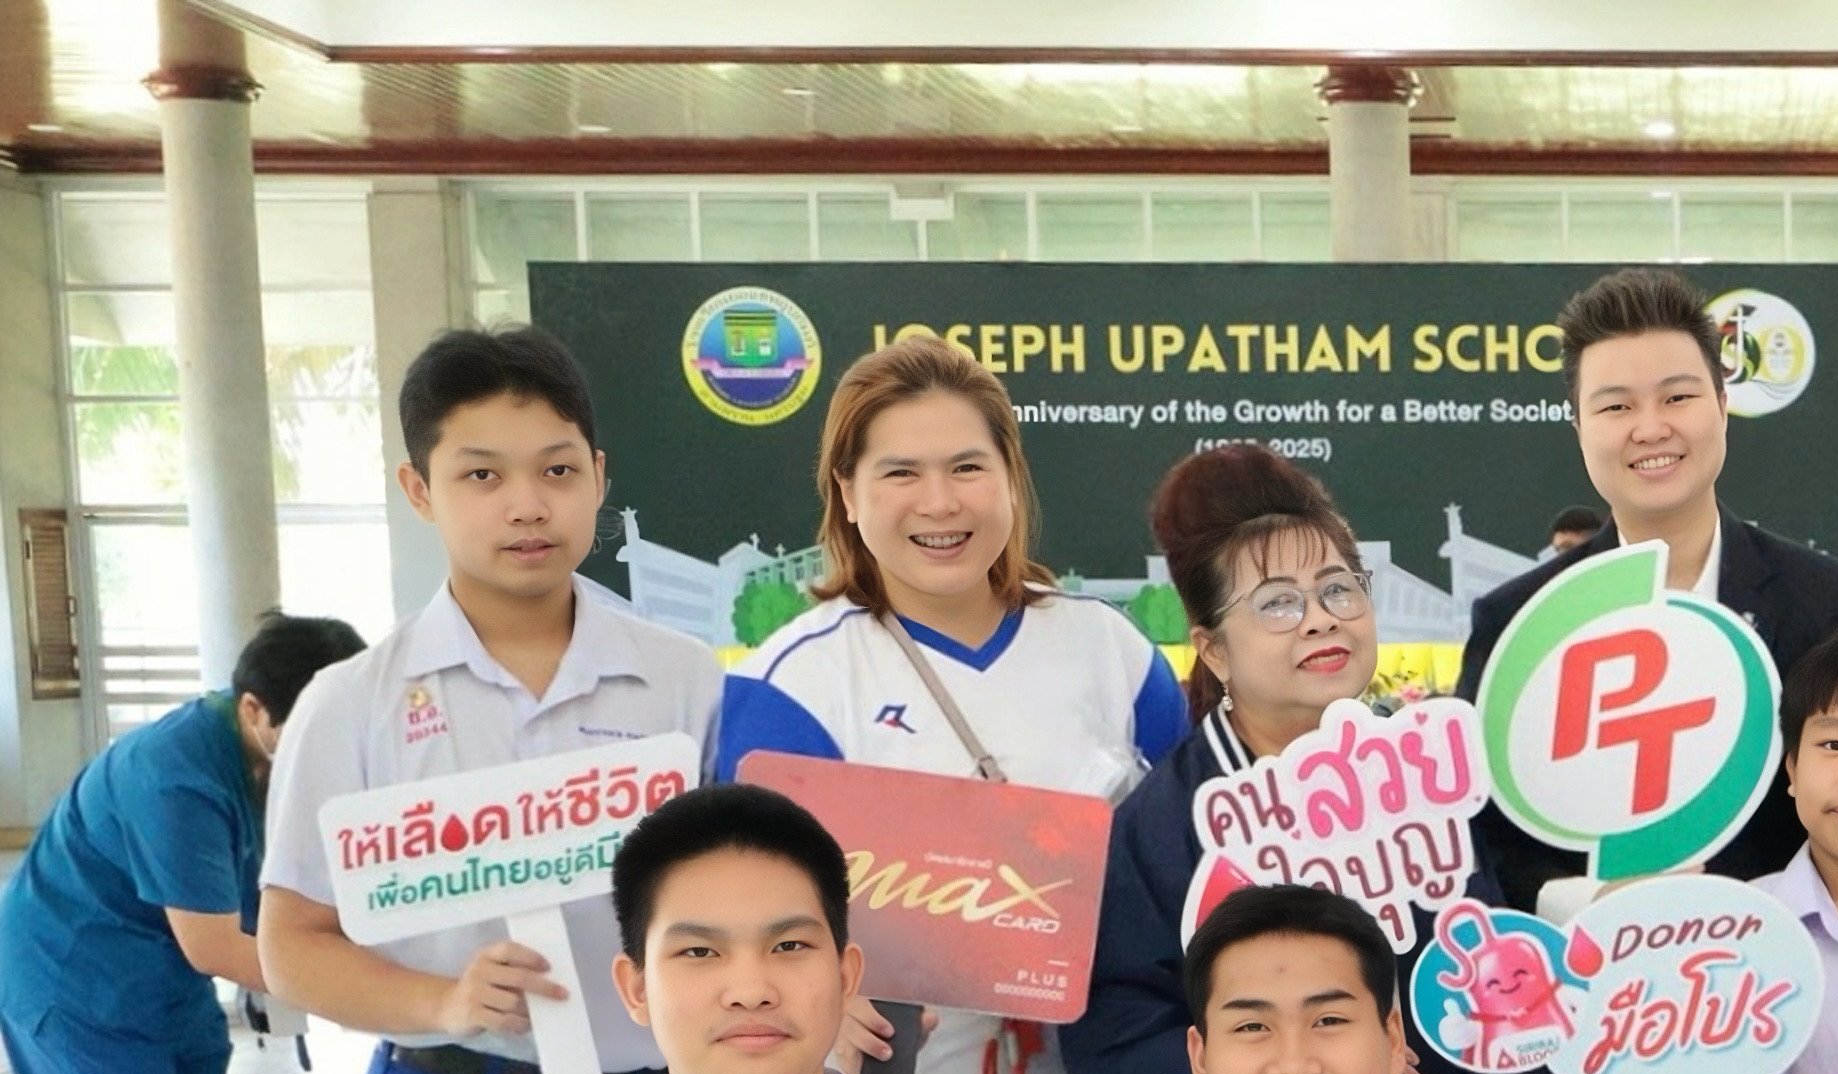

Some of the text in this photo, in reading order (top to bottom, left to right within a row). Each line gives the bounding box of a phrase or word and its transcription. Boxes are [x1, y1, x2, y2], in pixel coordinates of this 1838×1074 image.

[1109, 324, 1390, 372] UPATHAM
[1414, 324, 1566, 372] SCHO
[1012, 399, 1575, 428] nniversary of the Growth for a Better Societ
[1551, 628, 1717, 815] PT
[992, 912, 1062, 934] CARD
[1016, 968, 1068, 989] PLUS
